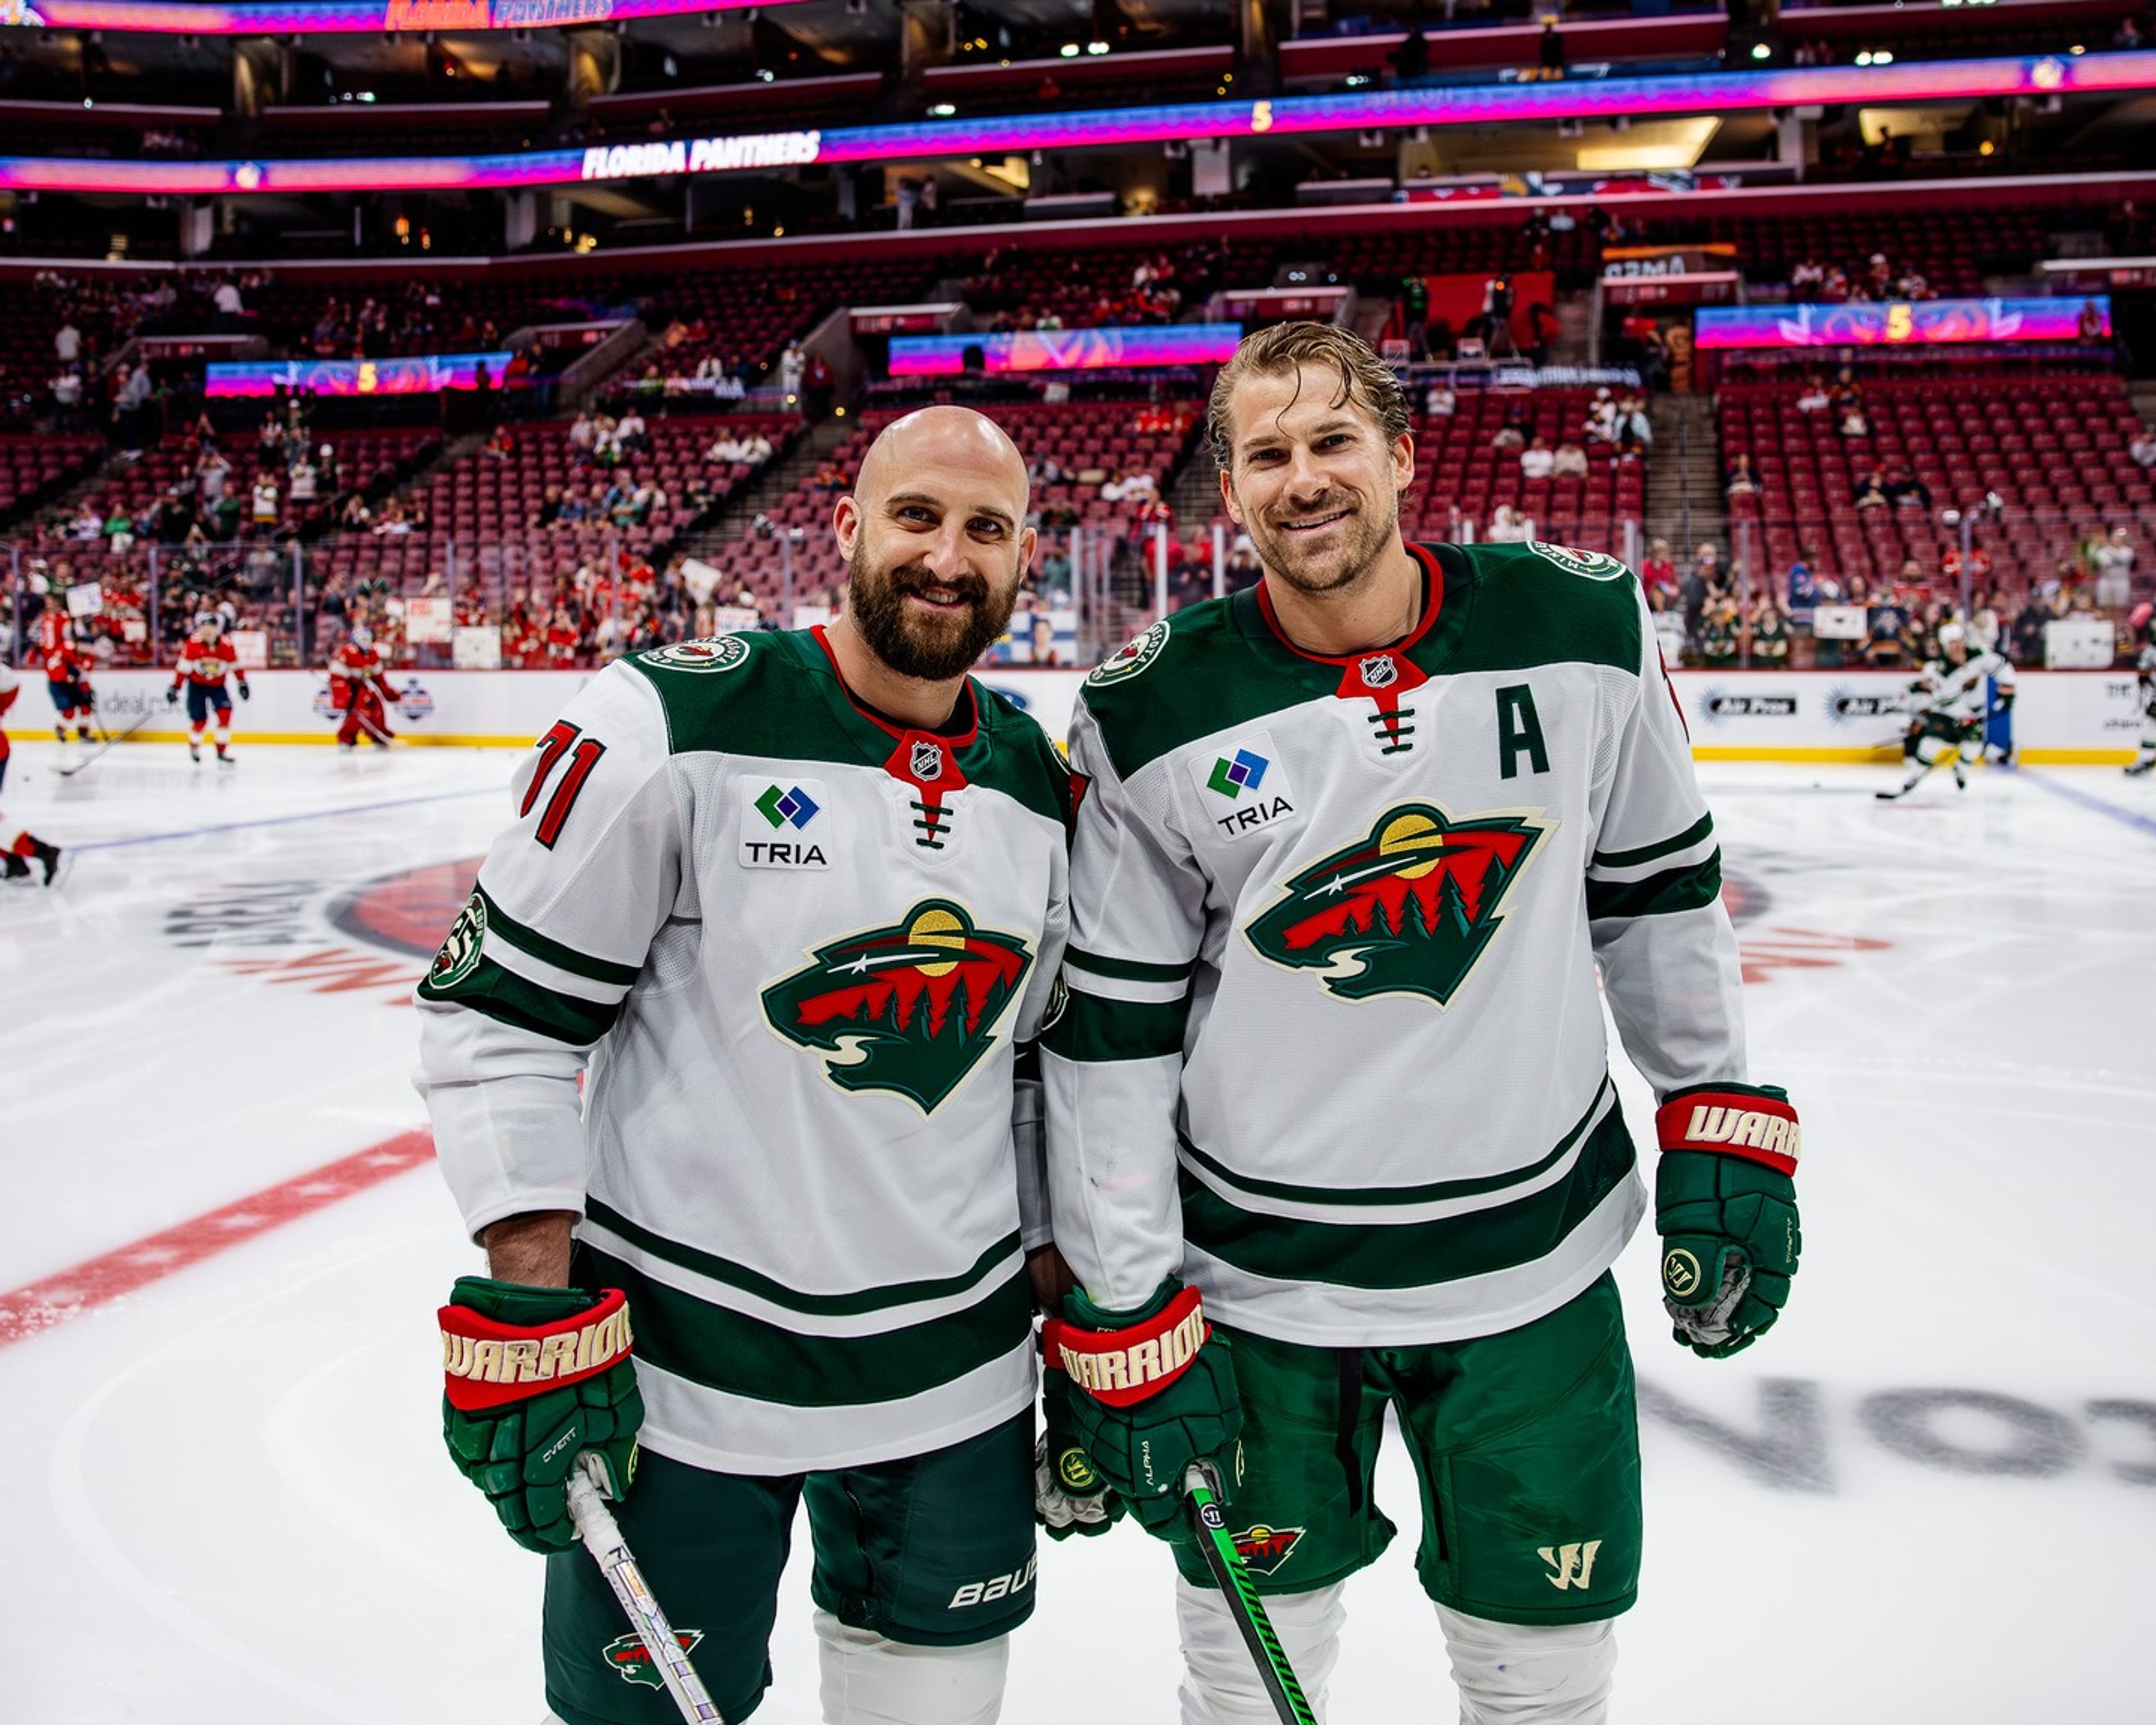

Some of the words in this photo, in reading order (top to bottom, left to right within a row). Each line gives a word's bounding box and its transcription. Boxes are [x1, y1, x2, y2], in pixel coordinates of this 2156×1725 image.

[1251, 101, 1274, 132] 5
[582, 140, 686, 179] FLORIDA
[690, 130, 821, 171] PANTHERS
[1886, 305, 1912, 339] 5
[358, 362, 377, 392] 5
[1496, 683, 1550, 780] A
[520, 719, 607, 851] 71
[1217, 796, 1294, 835] TRIA
[745, 843, 827, 864] TRIA
